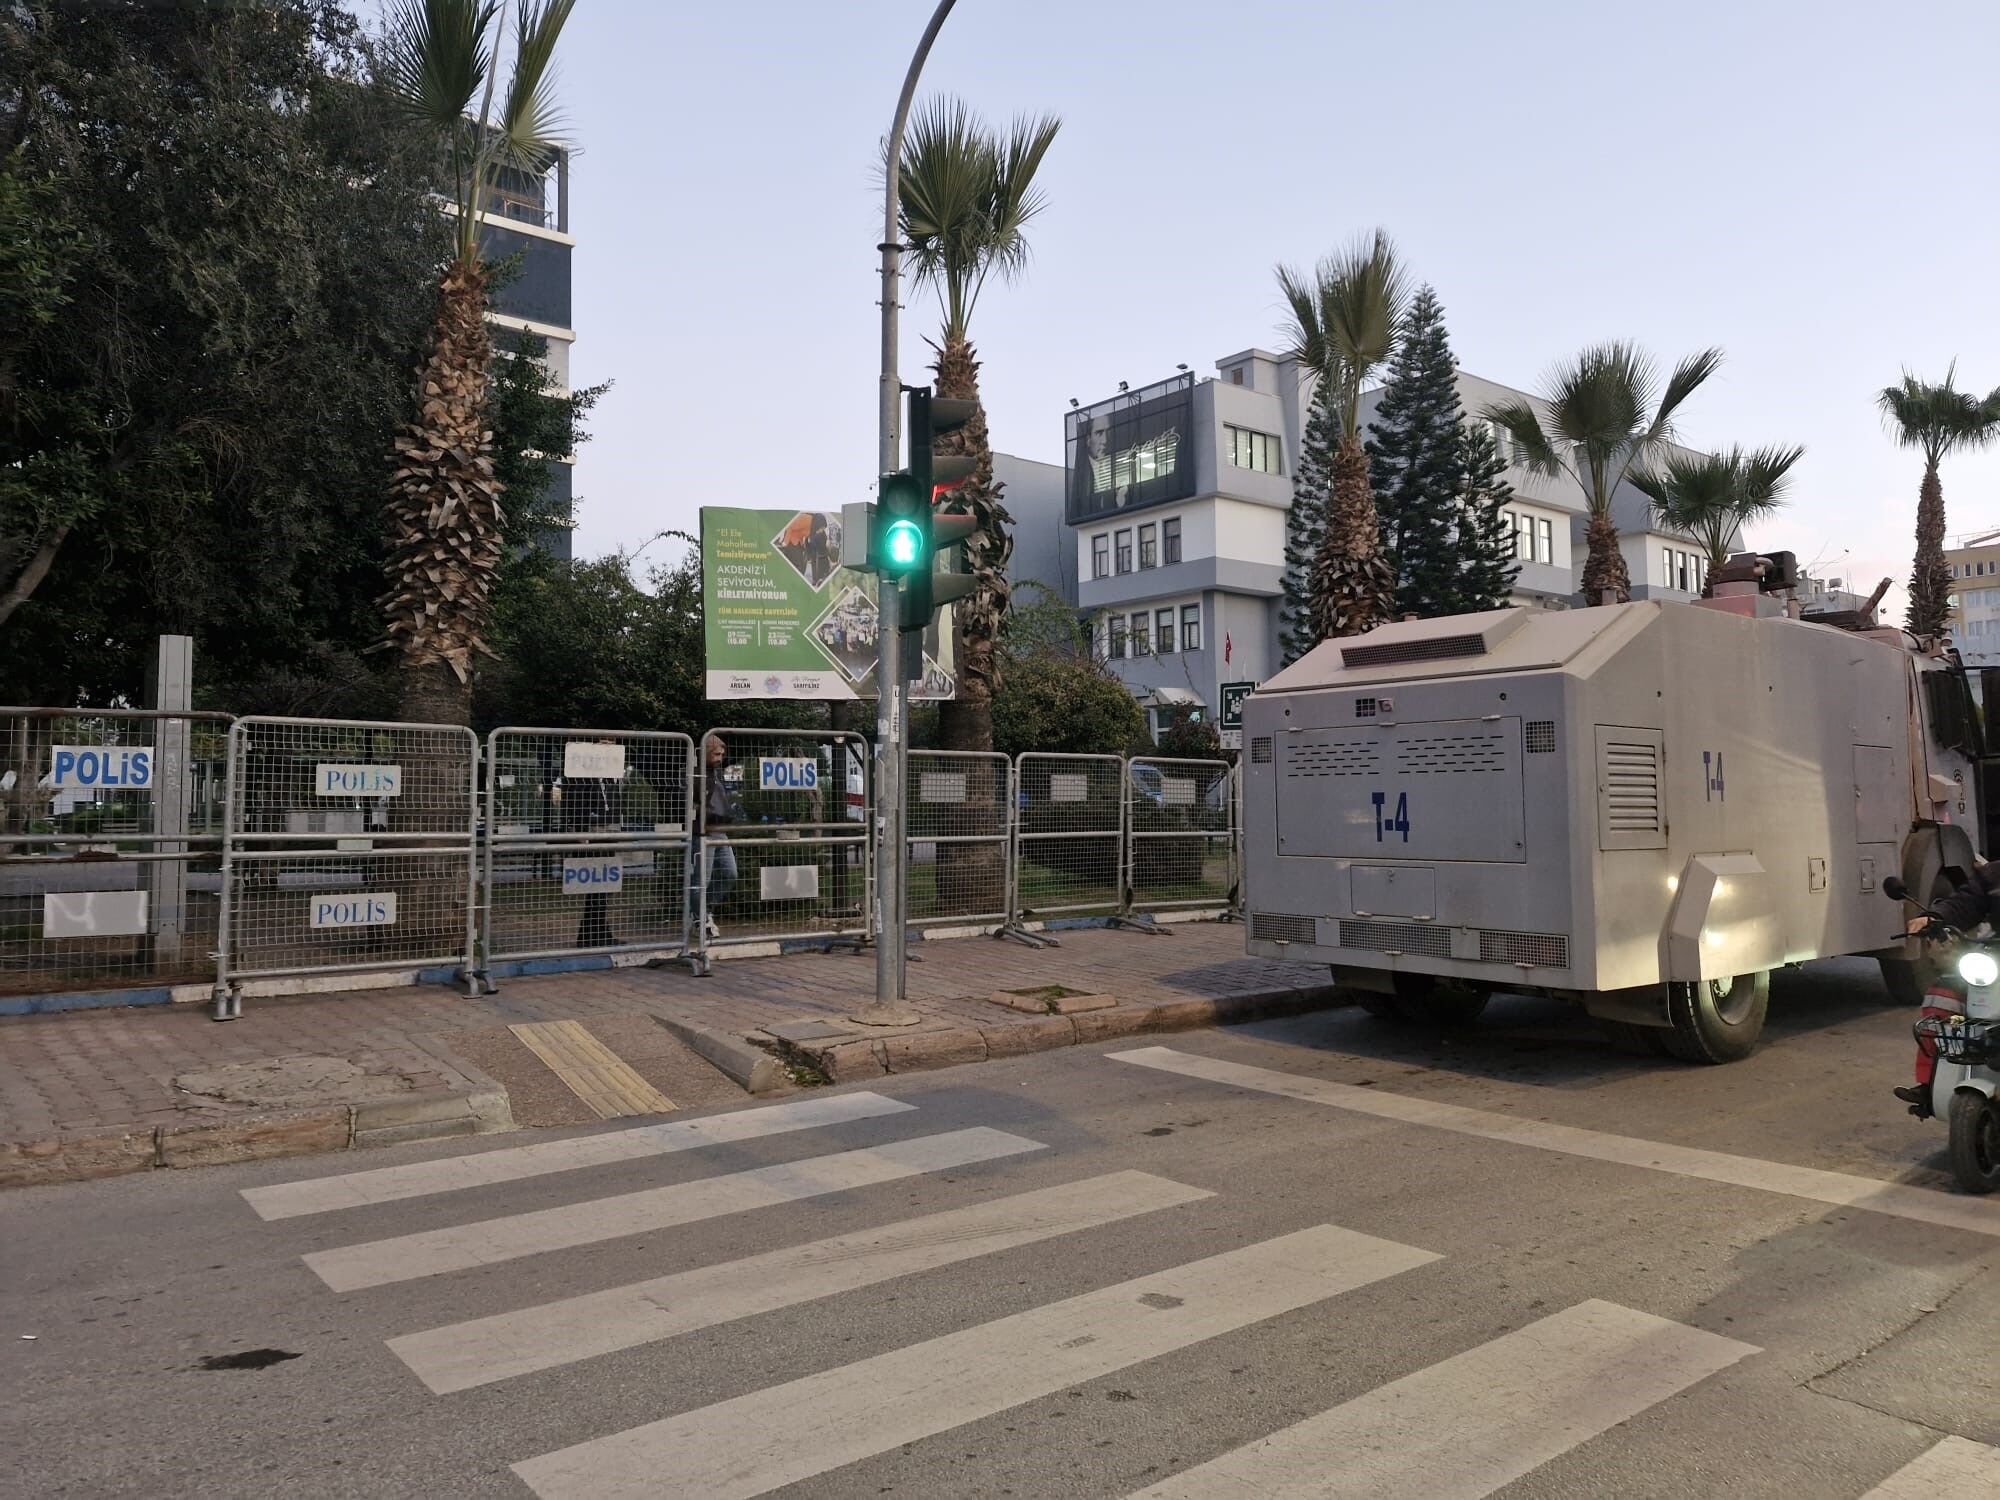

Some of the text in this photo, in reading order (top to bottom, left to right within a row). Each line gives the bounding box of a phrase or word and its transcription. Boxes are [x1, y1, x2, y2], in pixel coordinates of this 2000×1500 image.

[717, 576, 776, 589] SEVİYORUM,
[717, 587, 787, 600] KİRLETMİYORUM
[1371, 792, 1410, 843] T-4
[316, 899, 386, 924] POLİS
